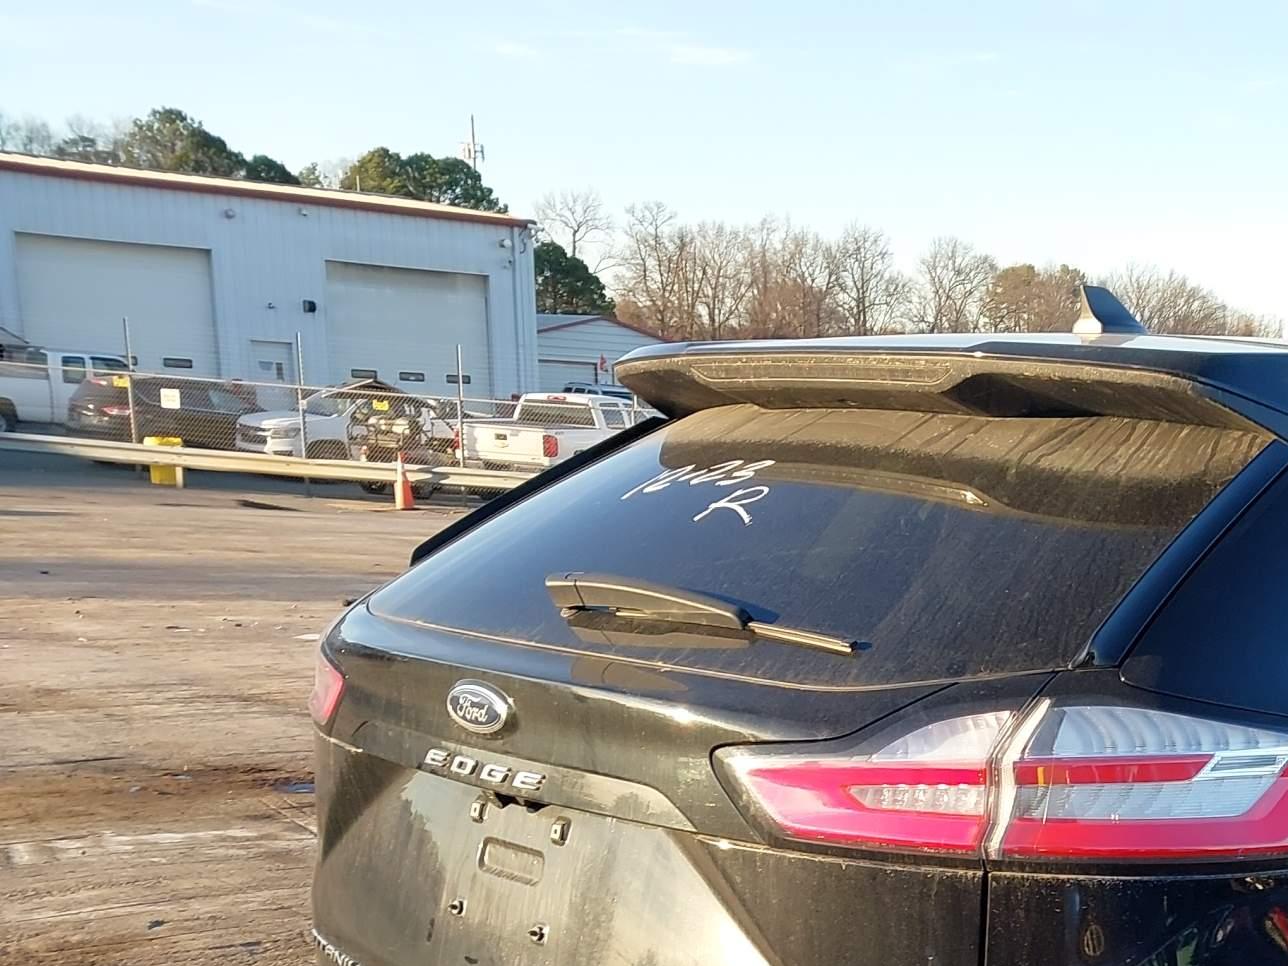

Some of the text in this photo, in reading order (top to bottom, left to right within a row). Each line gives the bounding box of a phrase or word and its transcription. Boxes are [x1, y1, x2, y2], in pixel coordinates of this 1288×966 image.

[693, 486, 770, 527] R
[456, 693, 489, 722] Ford
[424, 747, 546, 791] EDGE
